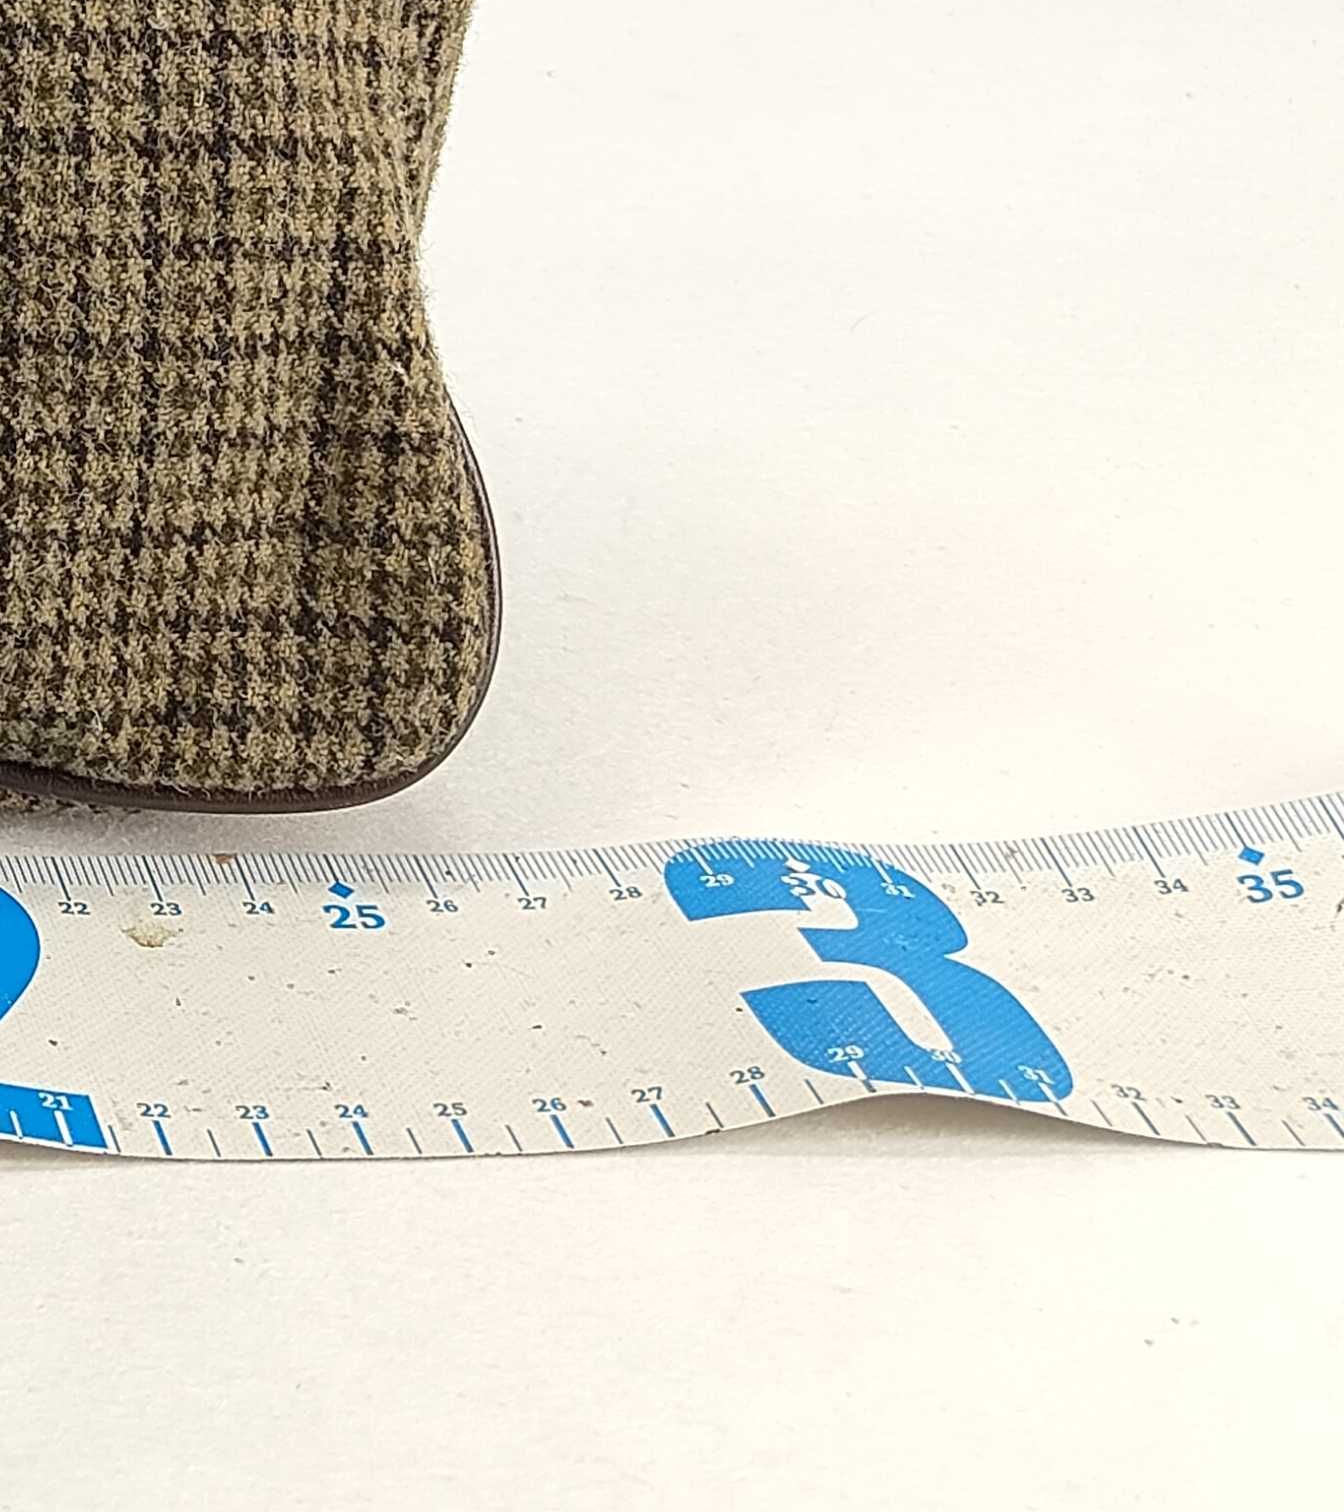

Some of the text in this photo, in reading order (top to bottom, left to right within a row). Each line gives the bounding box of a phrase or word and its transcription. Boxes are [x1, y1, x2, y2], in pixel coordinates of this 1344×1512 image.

[59, 902, 91, 915] 22
[151, 903, 182, 916] 23
[243, 901, 275, 914] 24
[323, 904, 385, 929] 25
[426, 899, 459, 913] 26
[518, 897, 546, 910] 27
[609, 887, 643, 901] 28
[700, 873, 735, 887] 29
[970, 890, 1005, 906] 32
[1062, 888, 1095, 903] 33
[1154, 878, 1189, 895] 34
[1237, 869, 1305, 903] 35
[663, 838, 1074, 1102] 3
[38, 1092, 73, 1111] 21
[136, 1103, 172, 1118] 22
[235, 1105, 270, 1120] 23
[334, 1104, 369, 1119] 24
[433, 1102, 468, 1117] 25
[532, 1098, 567, 1113] 26
[631, 1087, 663, 1104] 27
[730, 1066, 766, 1085] 28
[827, 1045, 865, 1063] 29
[930, 1048, 965, 1065] 30
[1017, 1064, 1055, 1085] 31
[1111, 1084, 1146, 1102] 32
[1205, 1094, 1241, 1110] 33
[1302, 1096, 1340, 1112] 34
